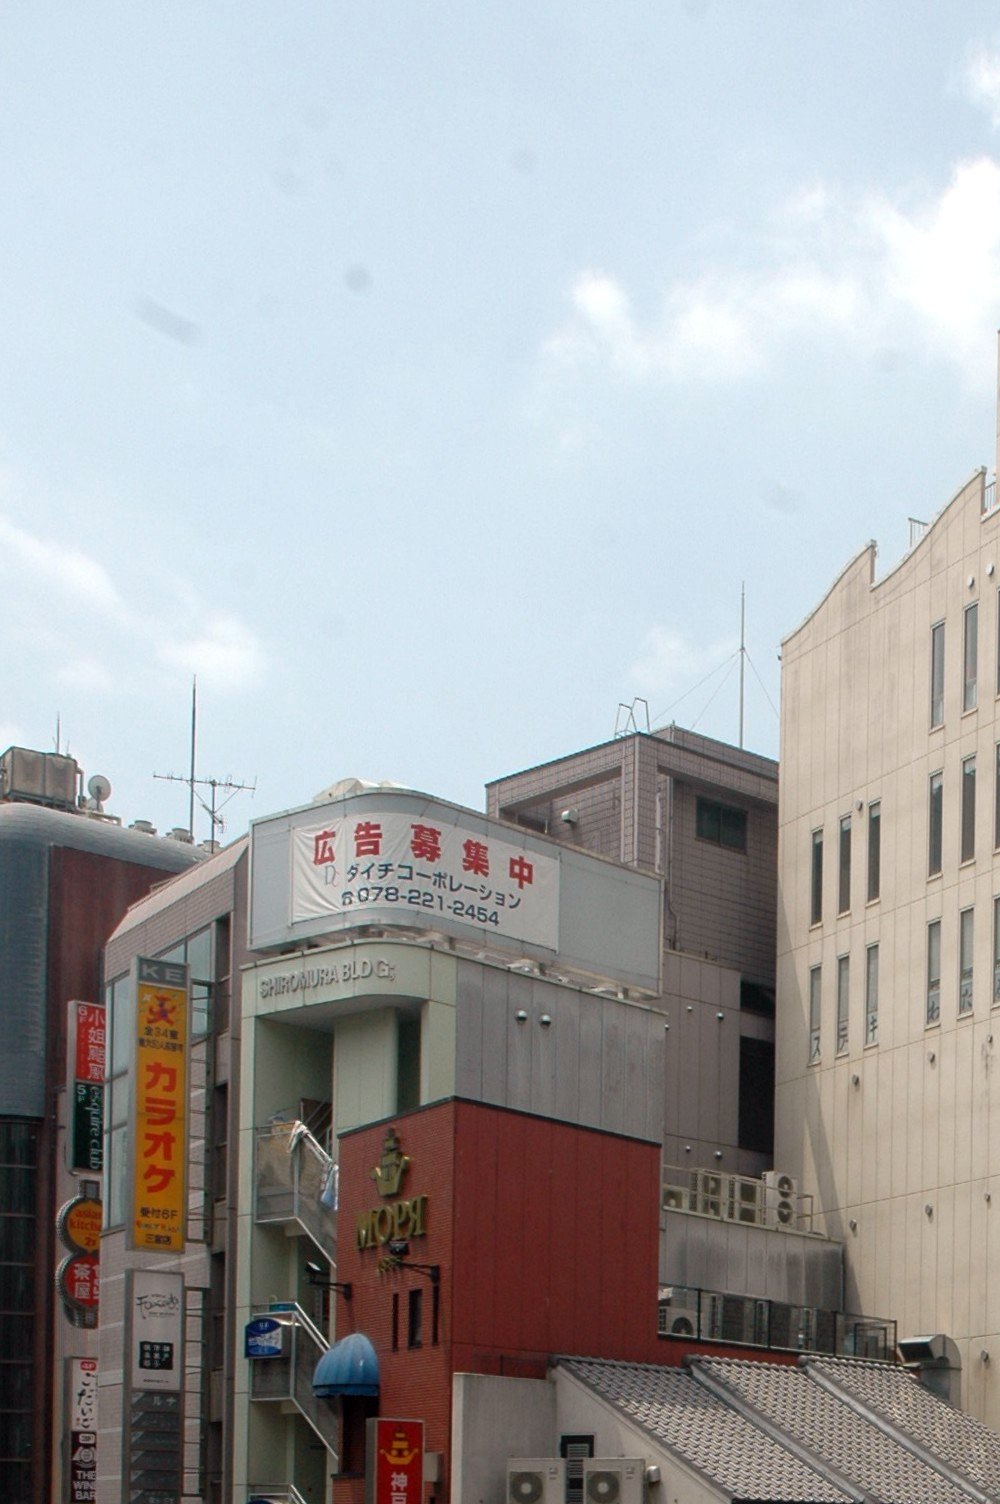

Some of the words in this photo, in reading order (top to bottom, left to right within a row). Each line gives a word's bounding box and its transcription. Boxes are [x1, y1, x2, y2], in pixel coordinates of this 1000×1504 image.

[313, 821, 534, 890] 広告募集中
[347, 862, 522, 909] ダイチコーポレーション
[358, 886, 500, 926] 078-221-2454
[259, 966, 339, 999] SHIROMURA
[143, 1061, 177, 1194] カラオケ
